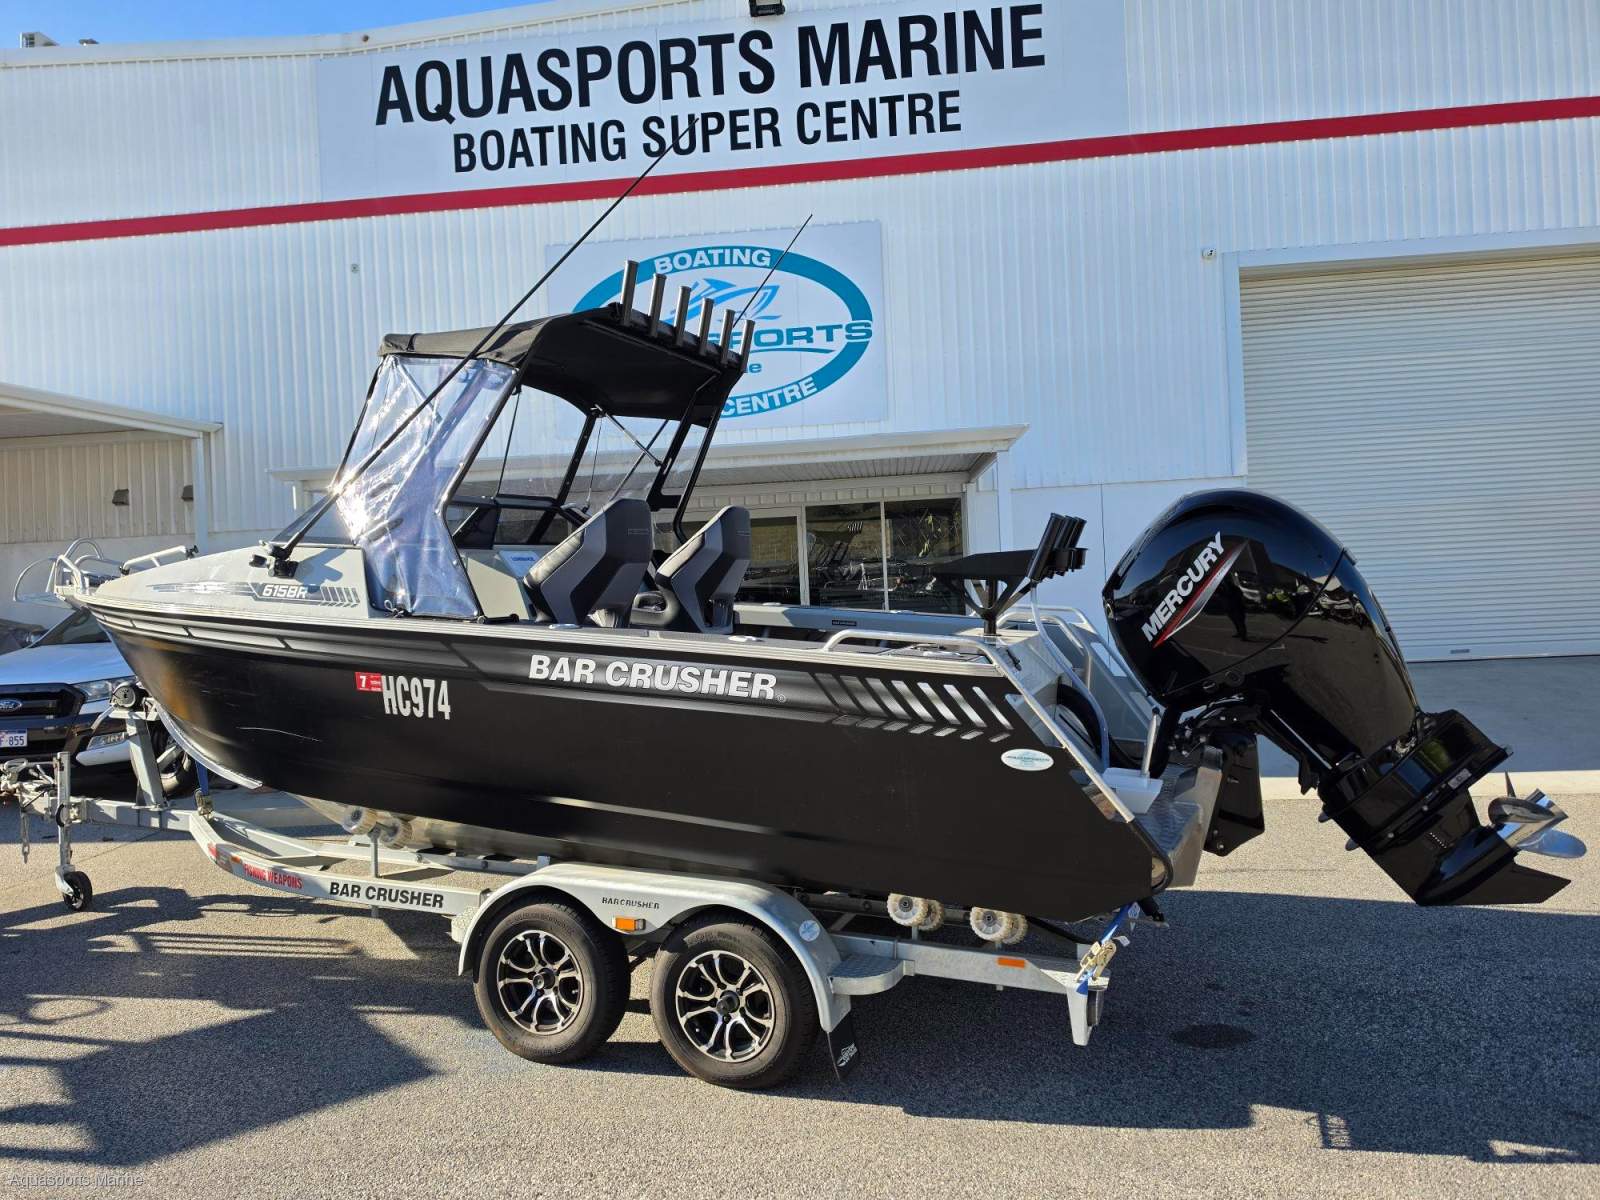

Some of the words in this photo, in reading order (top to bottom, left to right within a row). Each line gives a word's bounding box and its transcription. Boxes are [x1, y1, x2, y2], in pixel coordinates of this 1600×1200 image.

[375, 30, 775, 125] AQUASPORTS
[798, 4, 1045, 88] MARINE
[453, 120, 626, 172] BOATING
[642, 107, 781, 157] SUPER
[797, 90, 961, 145] CENTRE
[654, 248, 771, 275] BOATING
[721, 376, 818, 416] CENTRE
[1141, 531, 1225, 642] MERCURY
[381, 675, 451, 720] HC974
[528, 654, 596, 684] BAR
[605, 661, 777, 700] CRUSHER
[267, 871, 303, 889] WEAPONS
[329, 882, 361, 898] BAR
[365, 886, 444, 908] CRUSHER
